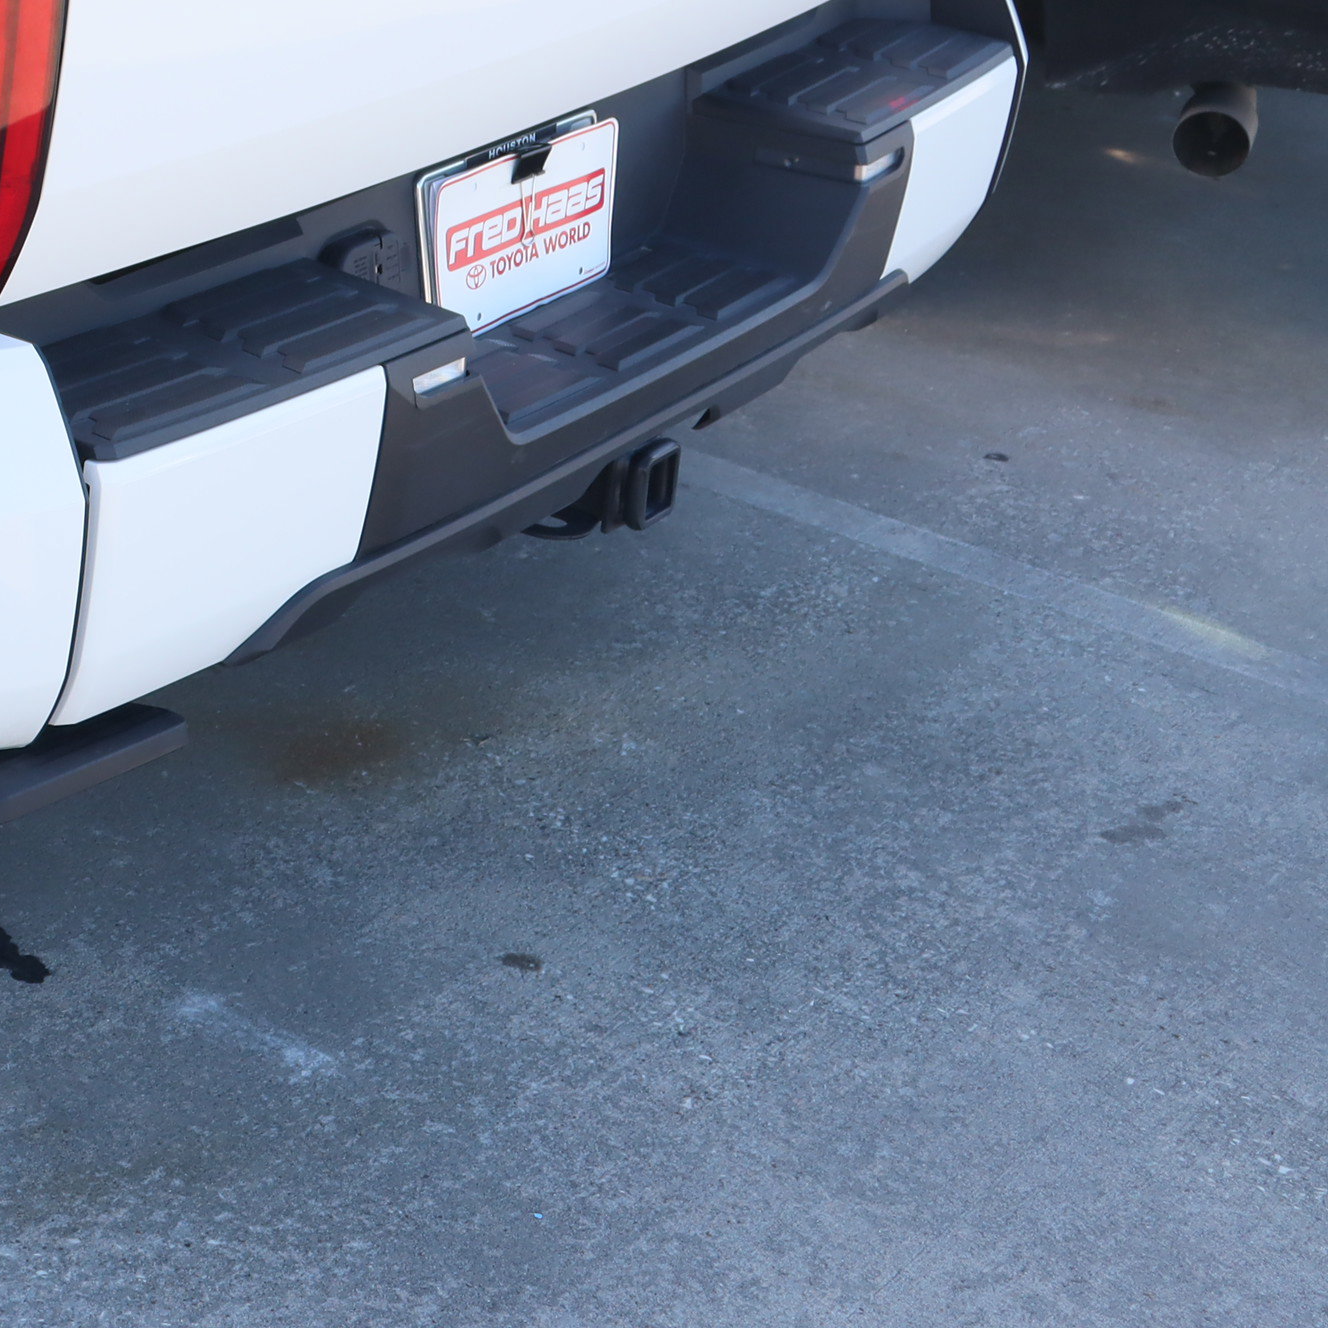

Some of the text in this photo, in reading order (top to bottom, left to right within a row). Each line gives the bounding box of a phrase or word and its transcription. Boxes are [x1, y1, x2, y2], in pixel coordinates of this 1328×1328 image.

[488, 132, 536, 160] HOUSTON
[490, 221, 591, 279] TOYOTA WORLD
